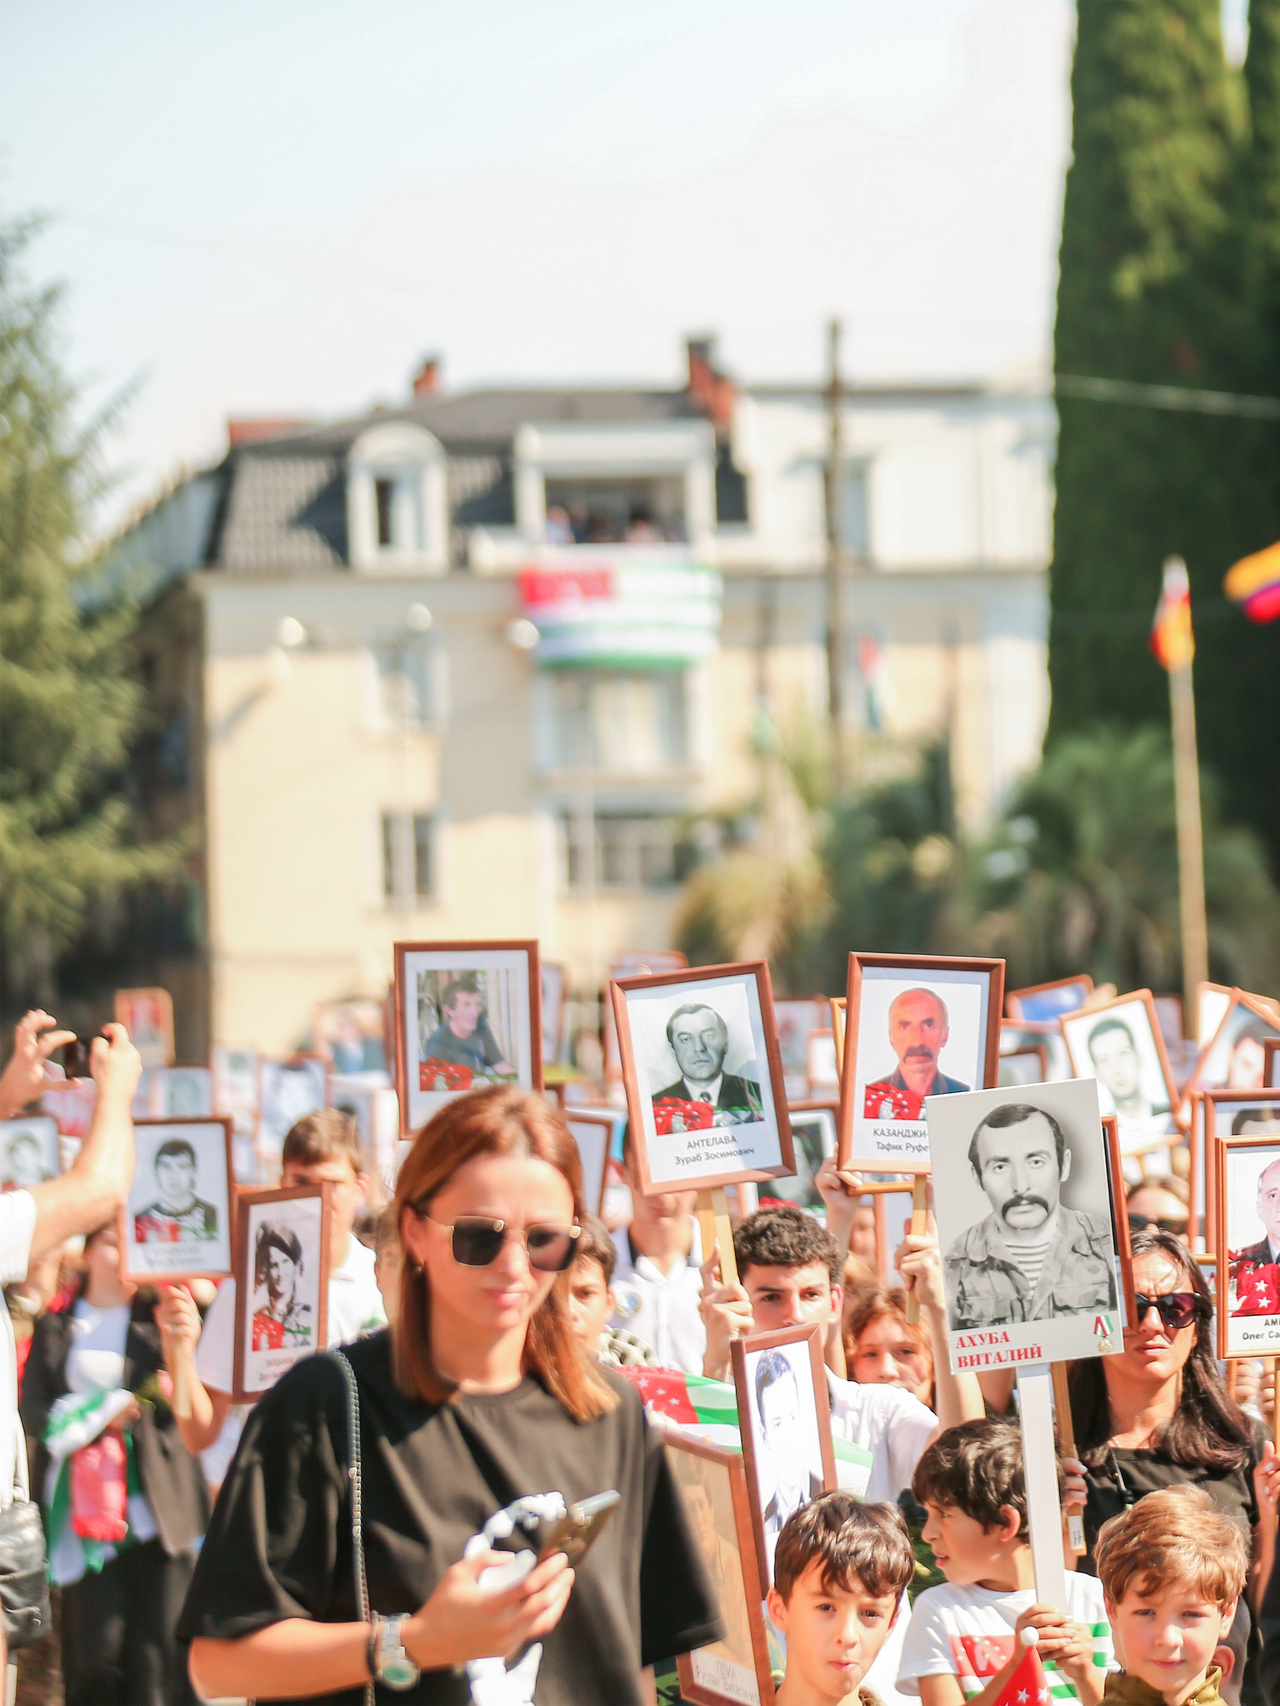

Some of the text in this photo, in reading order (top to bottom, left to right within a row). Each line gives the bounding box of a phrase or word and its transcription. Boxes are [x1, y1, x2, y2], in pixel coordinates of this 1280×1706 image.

[686, 1134, 738, 1149] АНТЕЛАВА
[876, 1141, 904, 1152] Тафик
[675, 1147, 755, 1165] Зураб Зосимович
[956, 1330, 1011, 1349] АХУБА
[1242, 1331, 1266, 1340] Олег
[957, 1342, 1043, 1368] ВИТАЛИЙ
